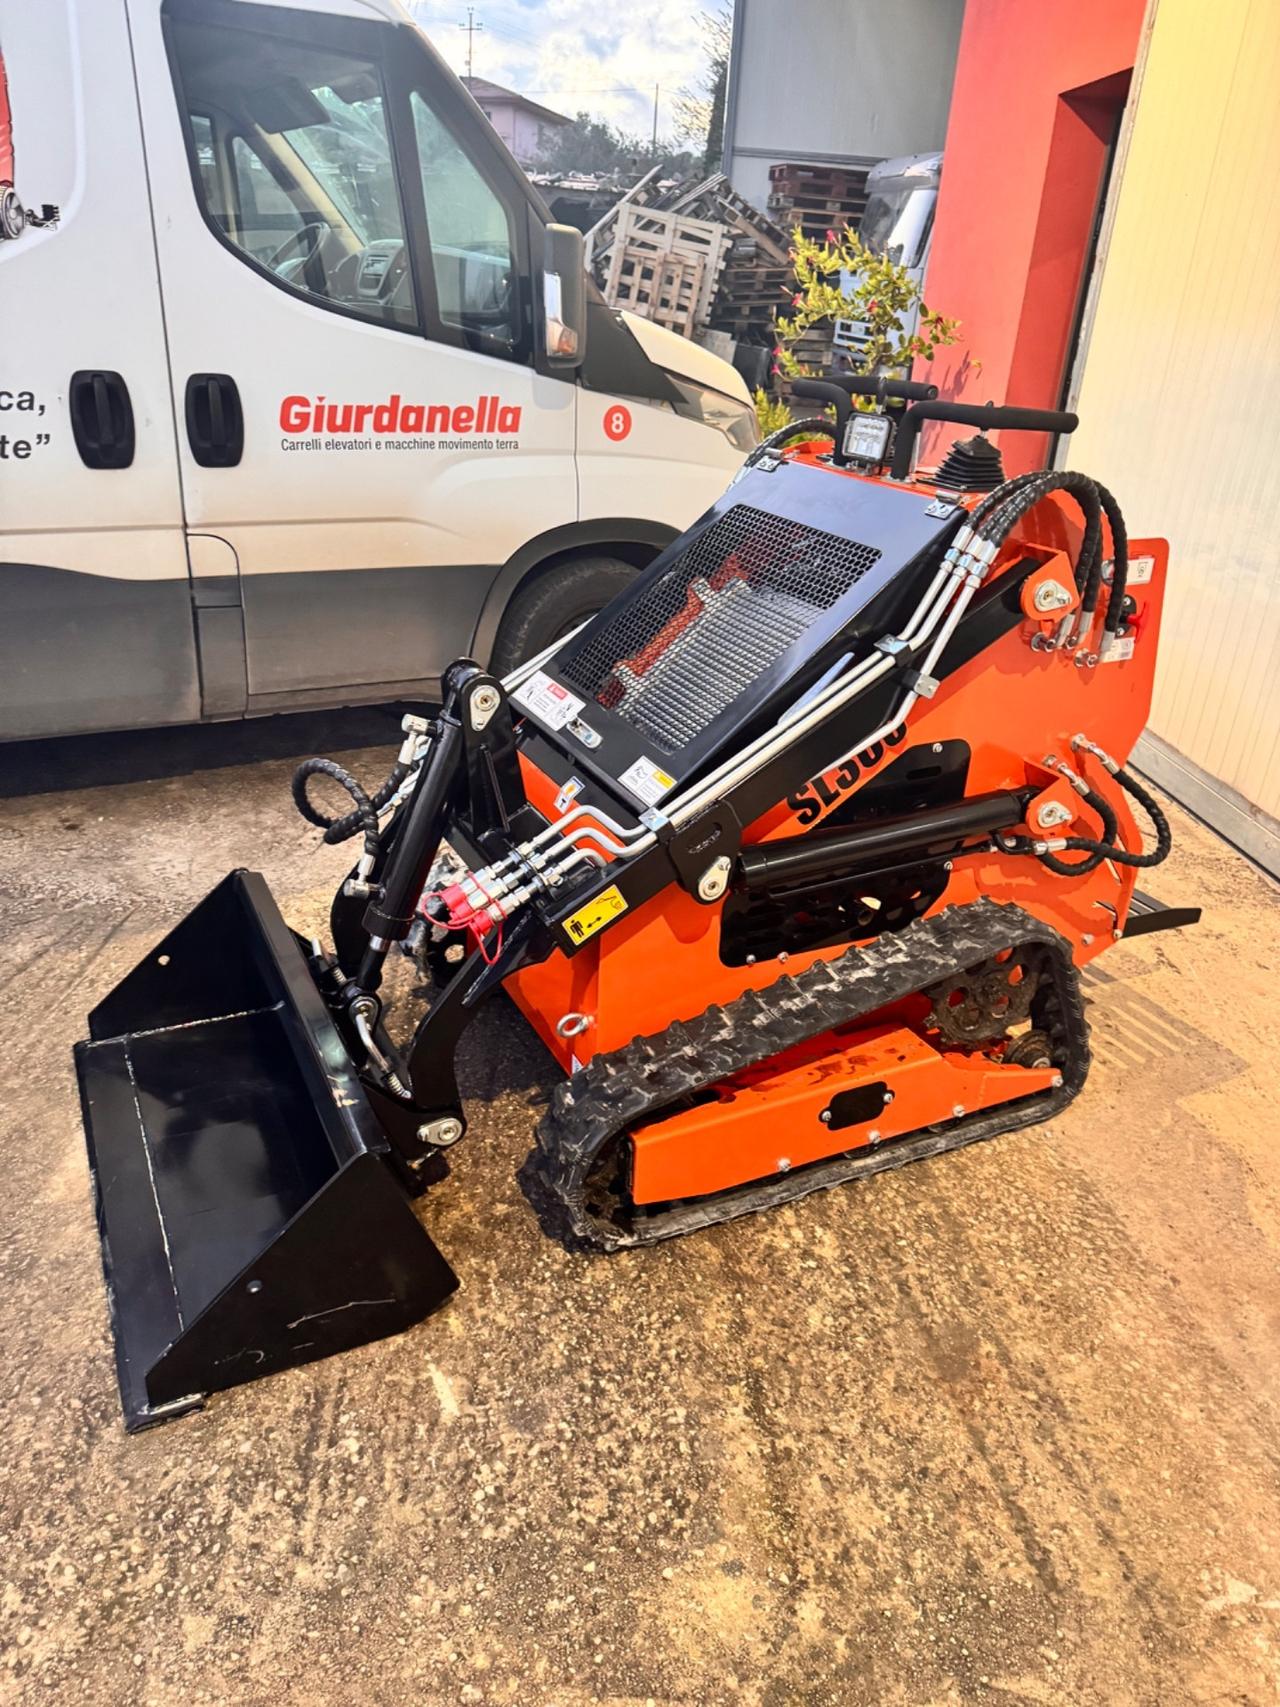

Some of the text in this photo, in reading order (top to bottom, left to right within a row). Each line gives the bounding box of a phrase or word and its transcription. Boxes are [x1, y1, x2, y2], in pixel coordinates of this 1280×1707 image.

[279, 395, 522, 433] Giurdanella
[611, 411, 624, 433] 8
[281, 437, 519, 451] Carrelli elevatori e macchine movimento terra
